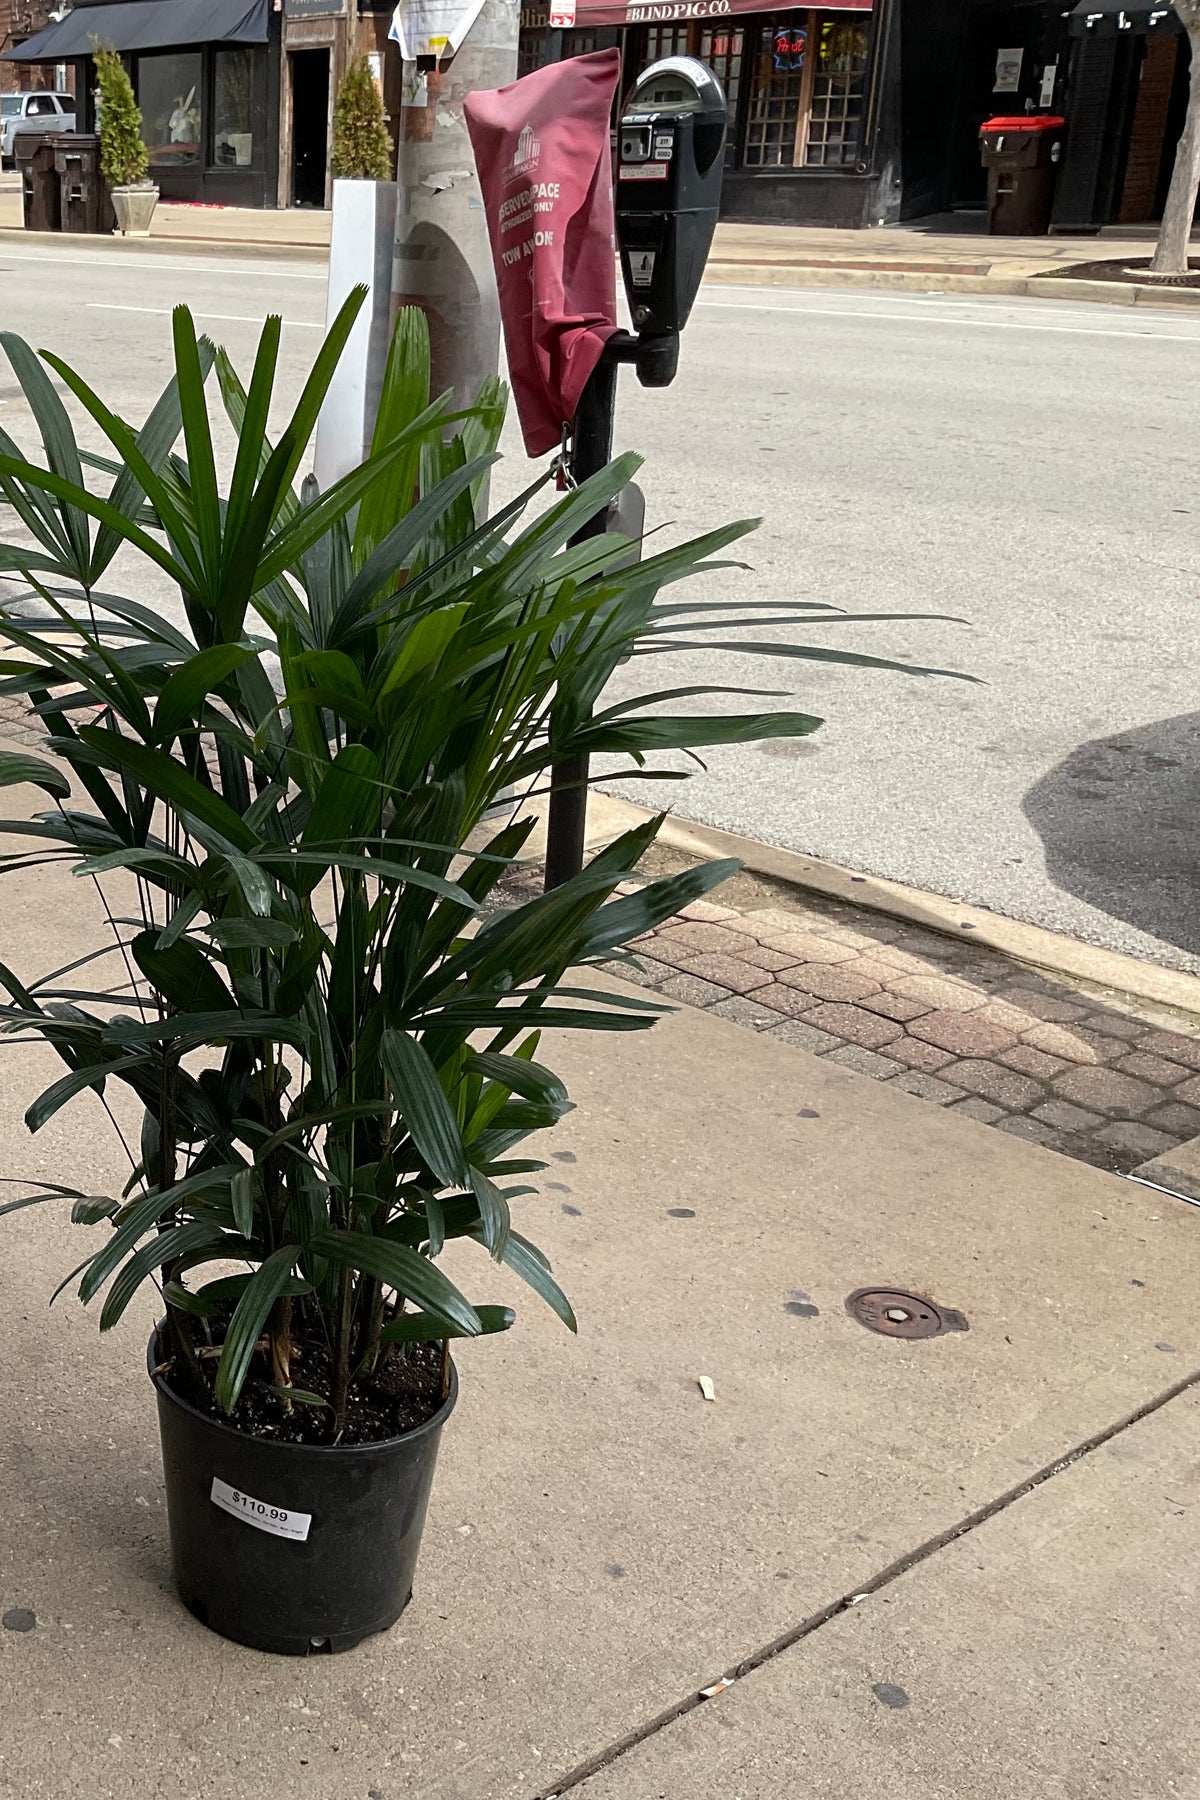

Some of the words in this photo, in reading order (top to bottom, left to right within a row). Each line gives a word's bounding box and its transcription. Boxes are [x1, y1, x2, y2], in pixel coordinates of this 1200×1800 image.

[632, 5, 672, 21] BLIND
[673, 2, 707, 19] PIG
[708, 0, 731, 15] CO.
[533, 202, 554, 213] ONLY
[502, 246, 521, 266] TOW
[232, 1491, 288, 1522] $110.99
